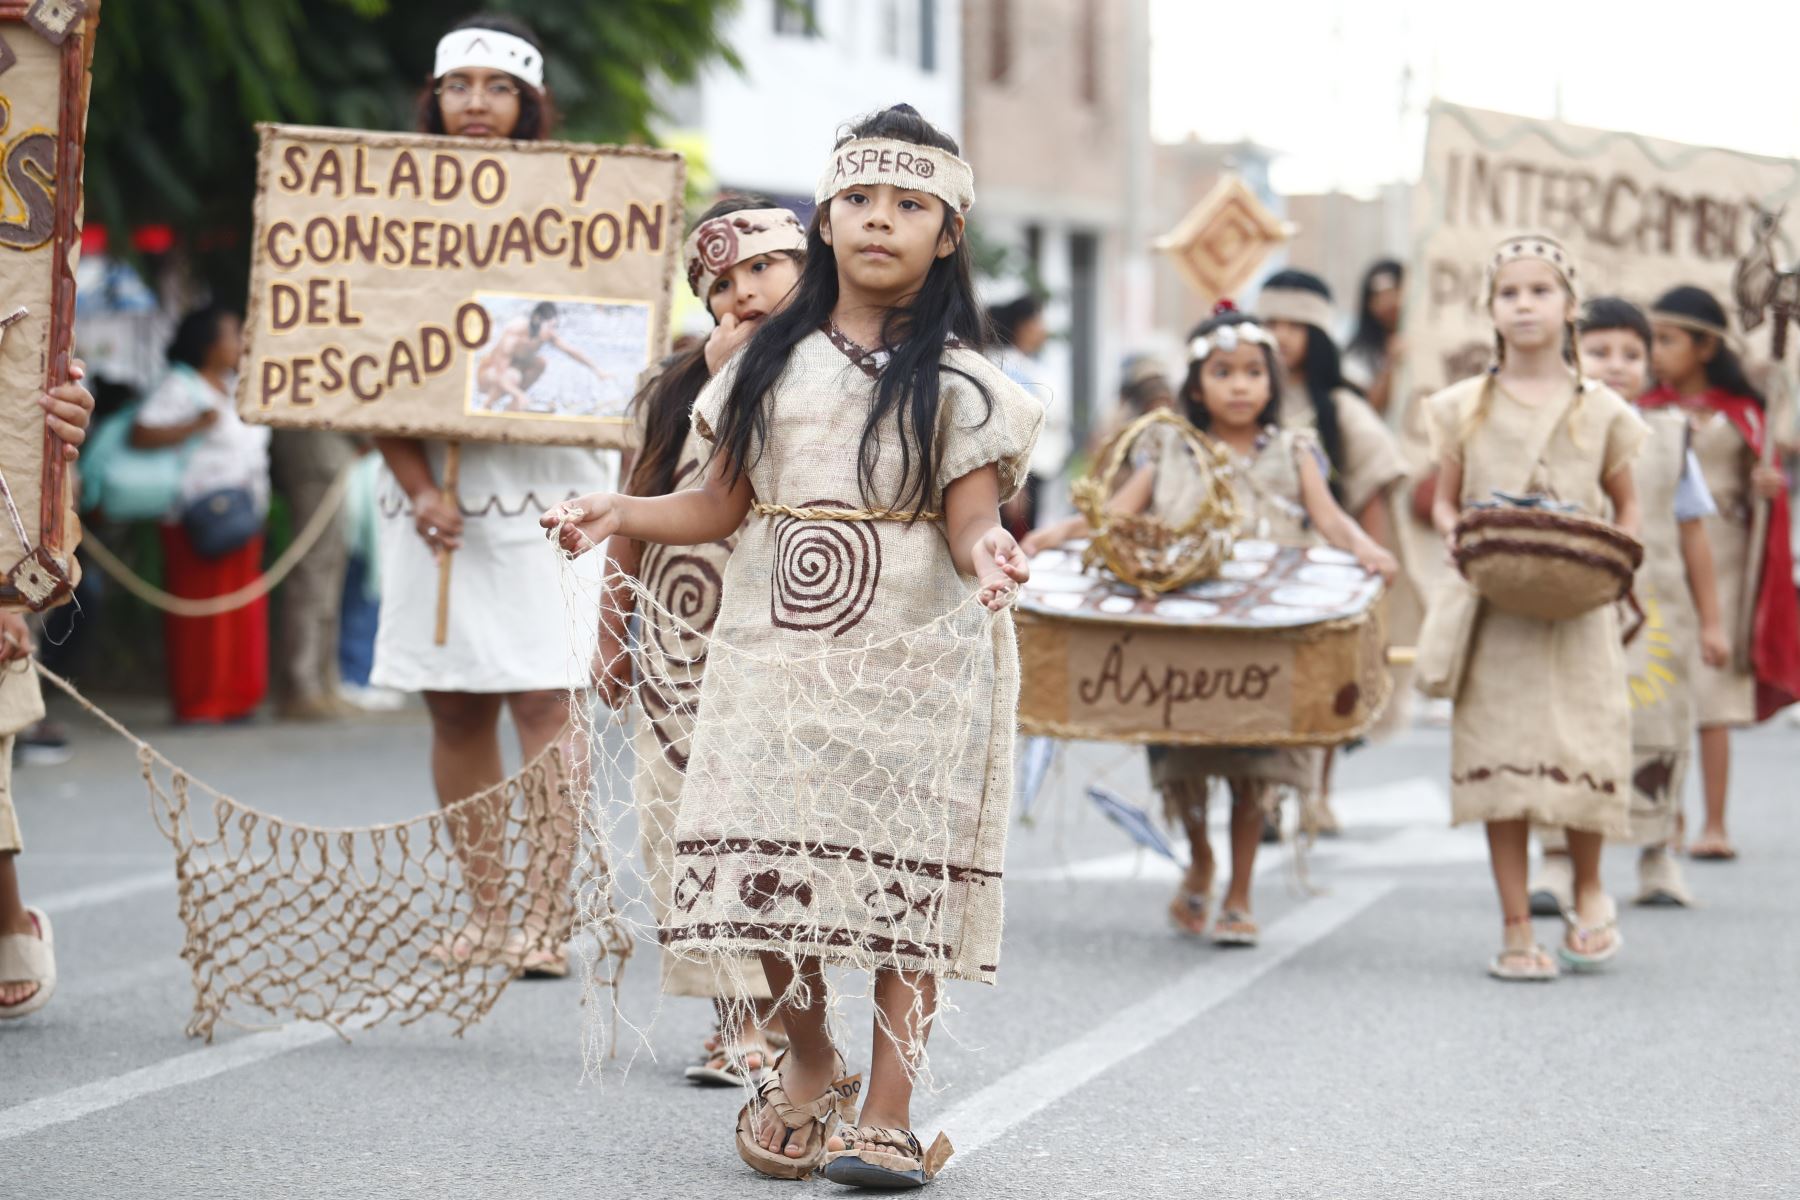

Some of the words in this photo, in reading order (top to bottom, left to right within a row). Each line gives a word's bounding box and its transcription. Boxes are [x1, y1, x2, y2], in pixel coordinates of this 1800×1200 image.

[279, 145, 507, 206] SALADO
[568, 156, 597, 202] Y
[1444, 152, 1760, 262] INTERCAMBI
[266, 203, 664, 270] CONSERVACION
[270, 279, 361, 332] DEL
[260, 301, 491, 407] PESCADO
[1078, 632, 1280, 728] Áspero
